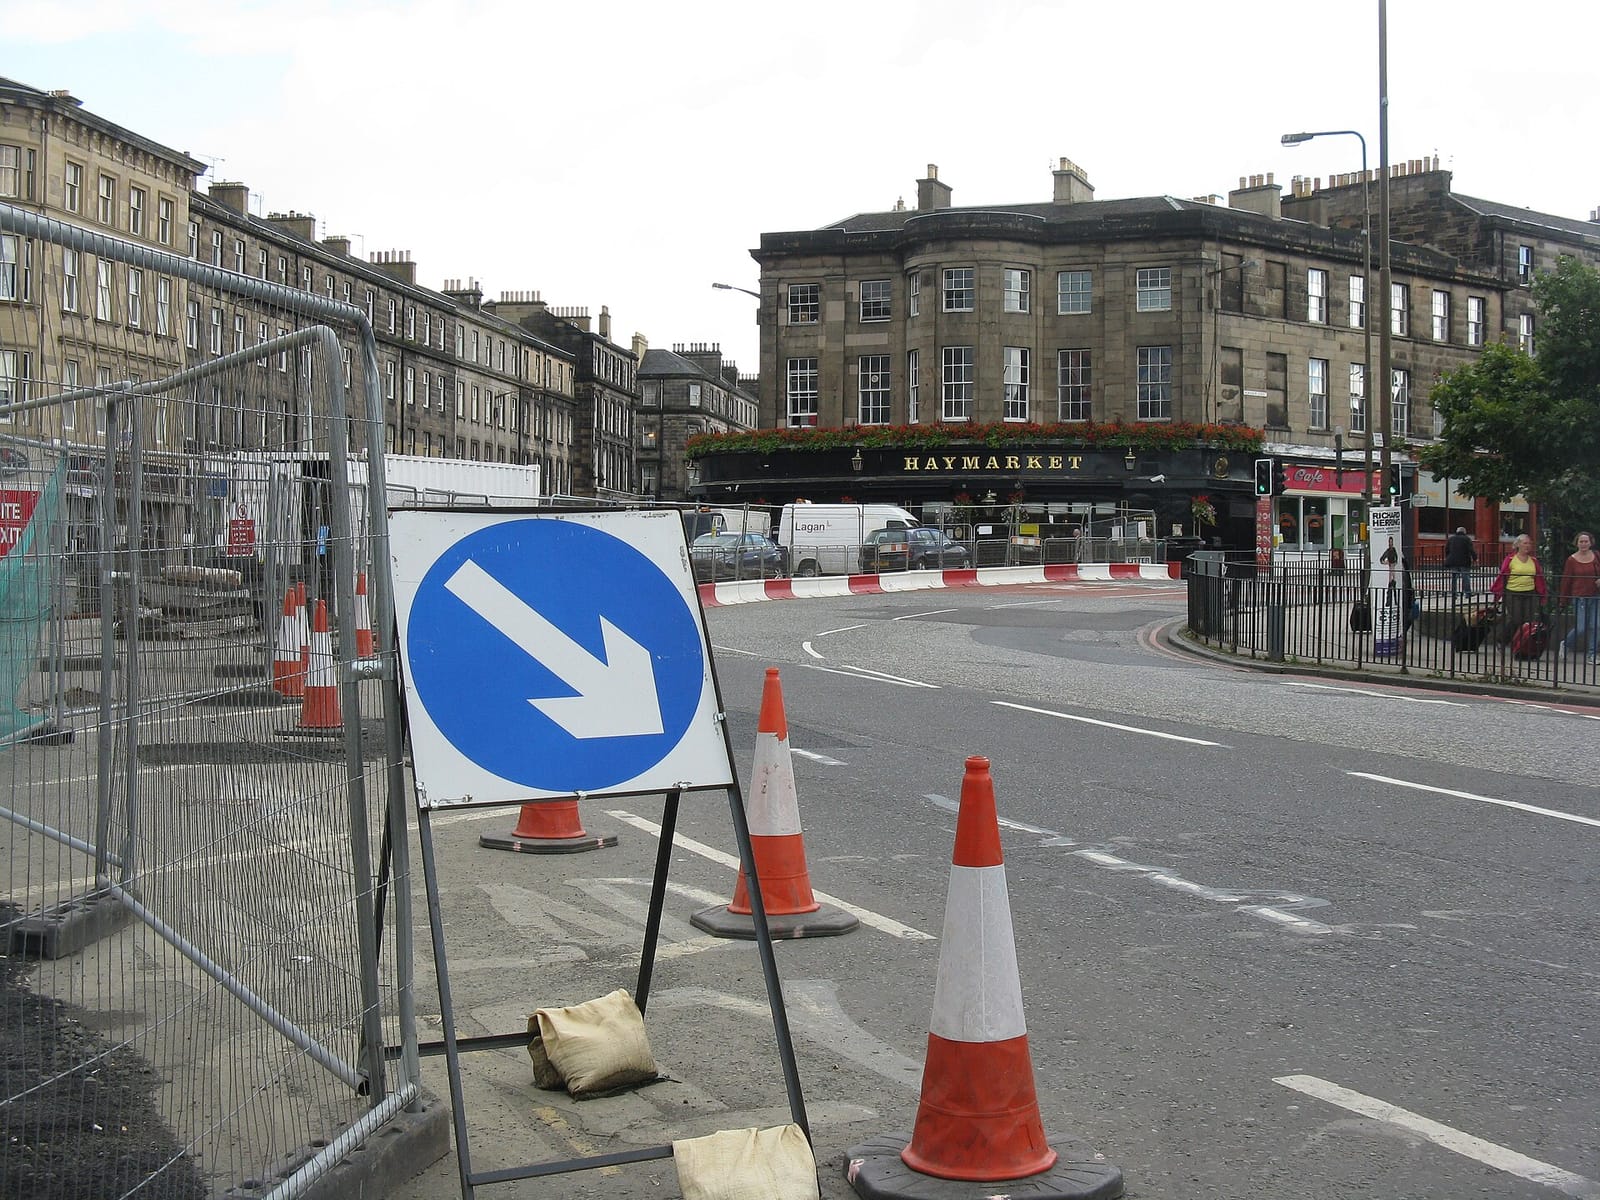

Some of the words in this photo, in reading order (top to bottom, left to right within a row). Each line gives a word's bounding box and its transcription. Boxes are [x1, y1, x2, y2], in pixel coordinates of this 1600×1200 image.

[904, 455, 1083, 471] HAYMARKET
[1294, 468, 1324, 488] Cafe
[1372, 511, 1401, 520] RICHARD
[795, 521, 825, 534] Lagan
[1372, 518, 1401, 527] HERRING
